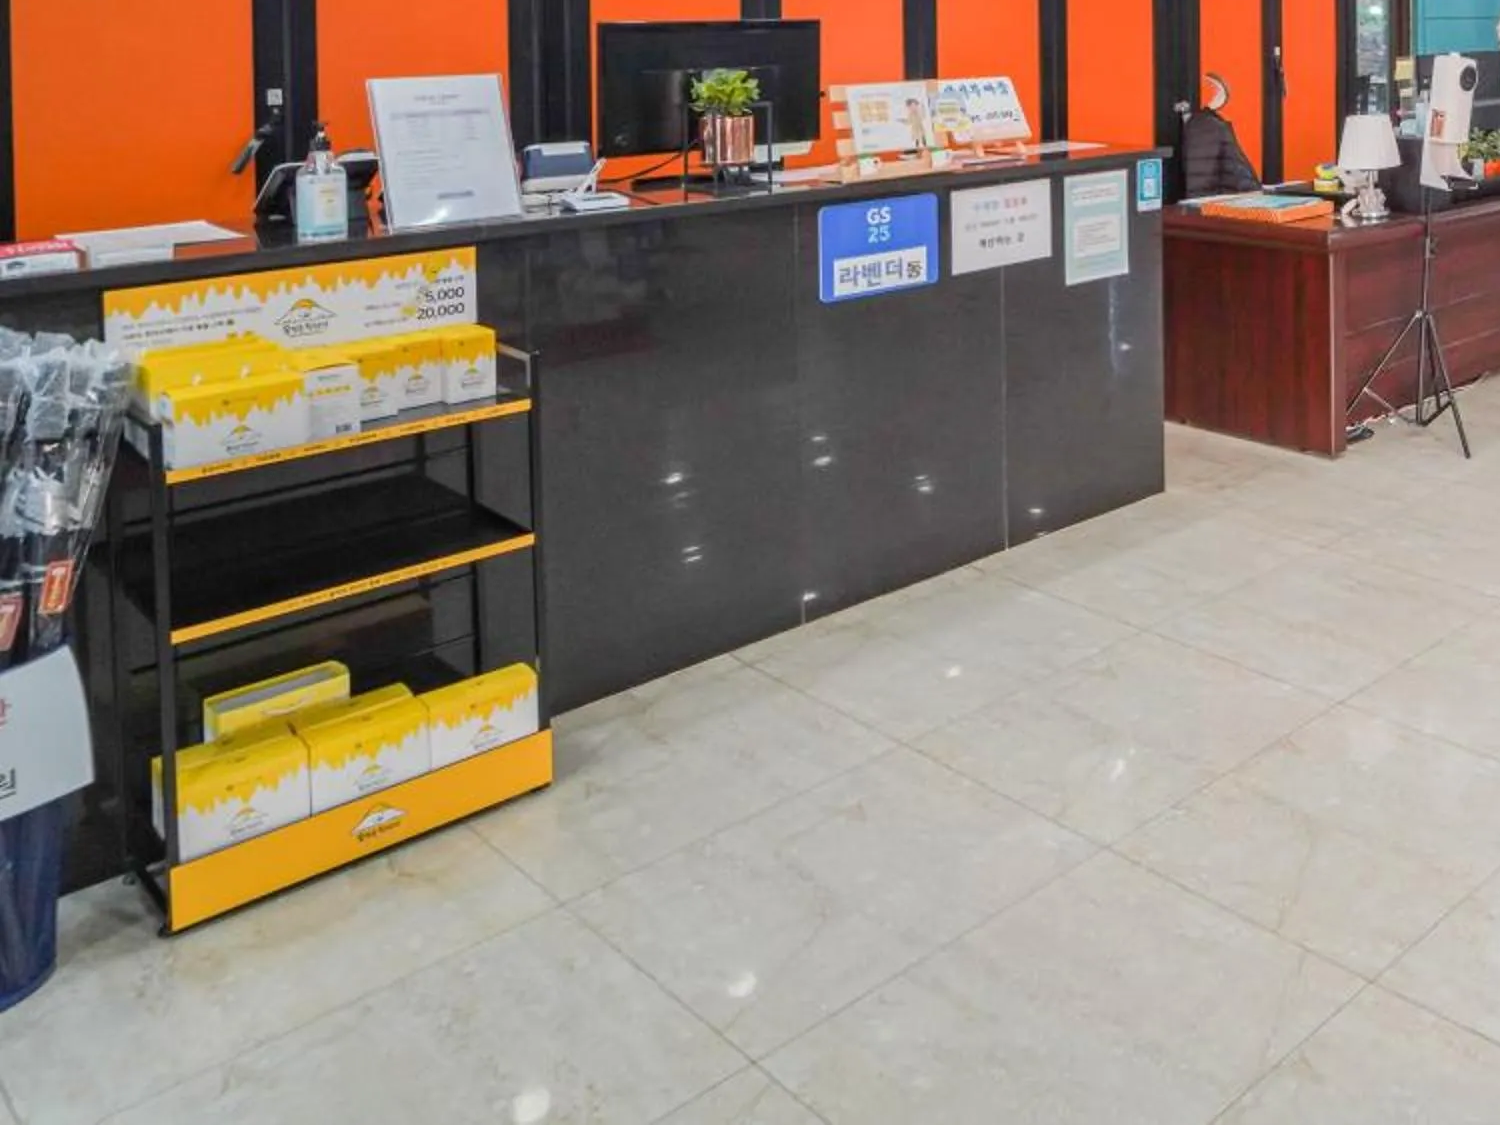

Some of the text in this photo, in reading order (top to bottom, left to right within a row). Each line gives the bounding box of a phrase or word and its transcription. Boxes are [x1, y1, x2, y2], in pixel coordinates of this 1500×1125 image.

[866, 206, 892, 225] GS
[867, 225, 892, 243] 25
[417, 302, 466, 321] 20,000
